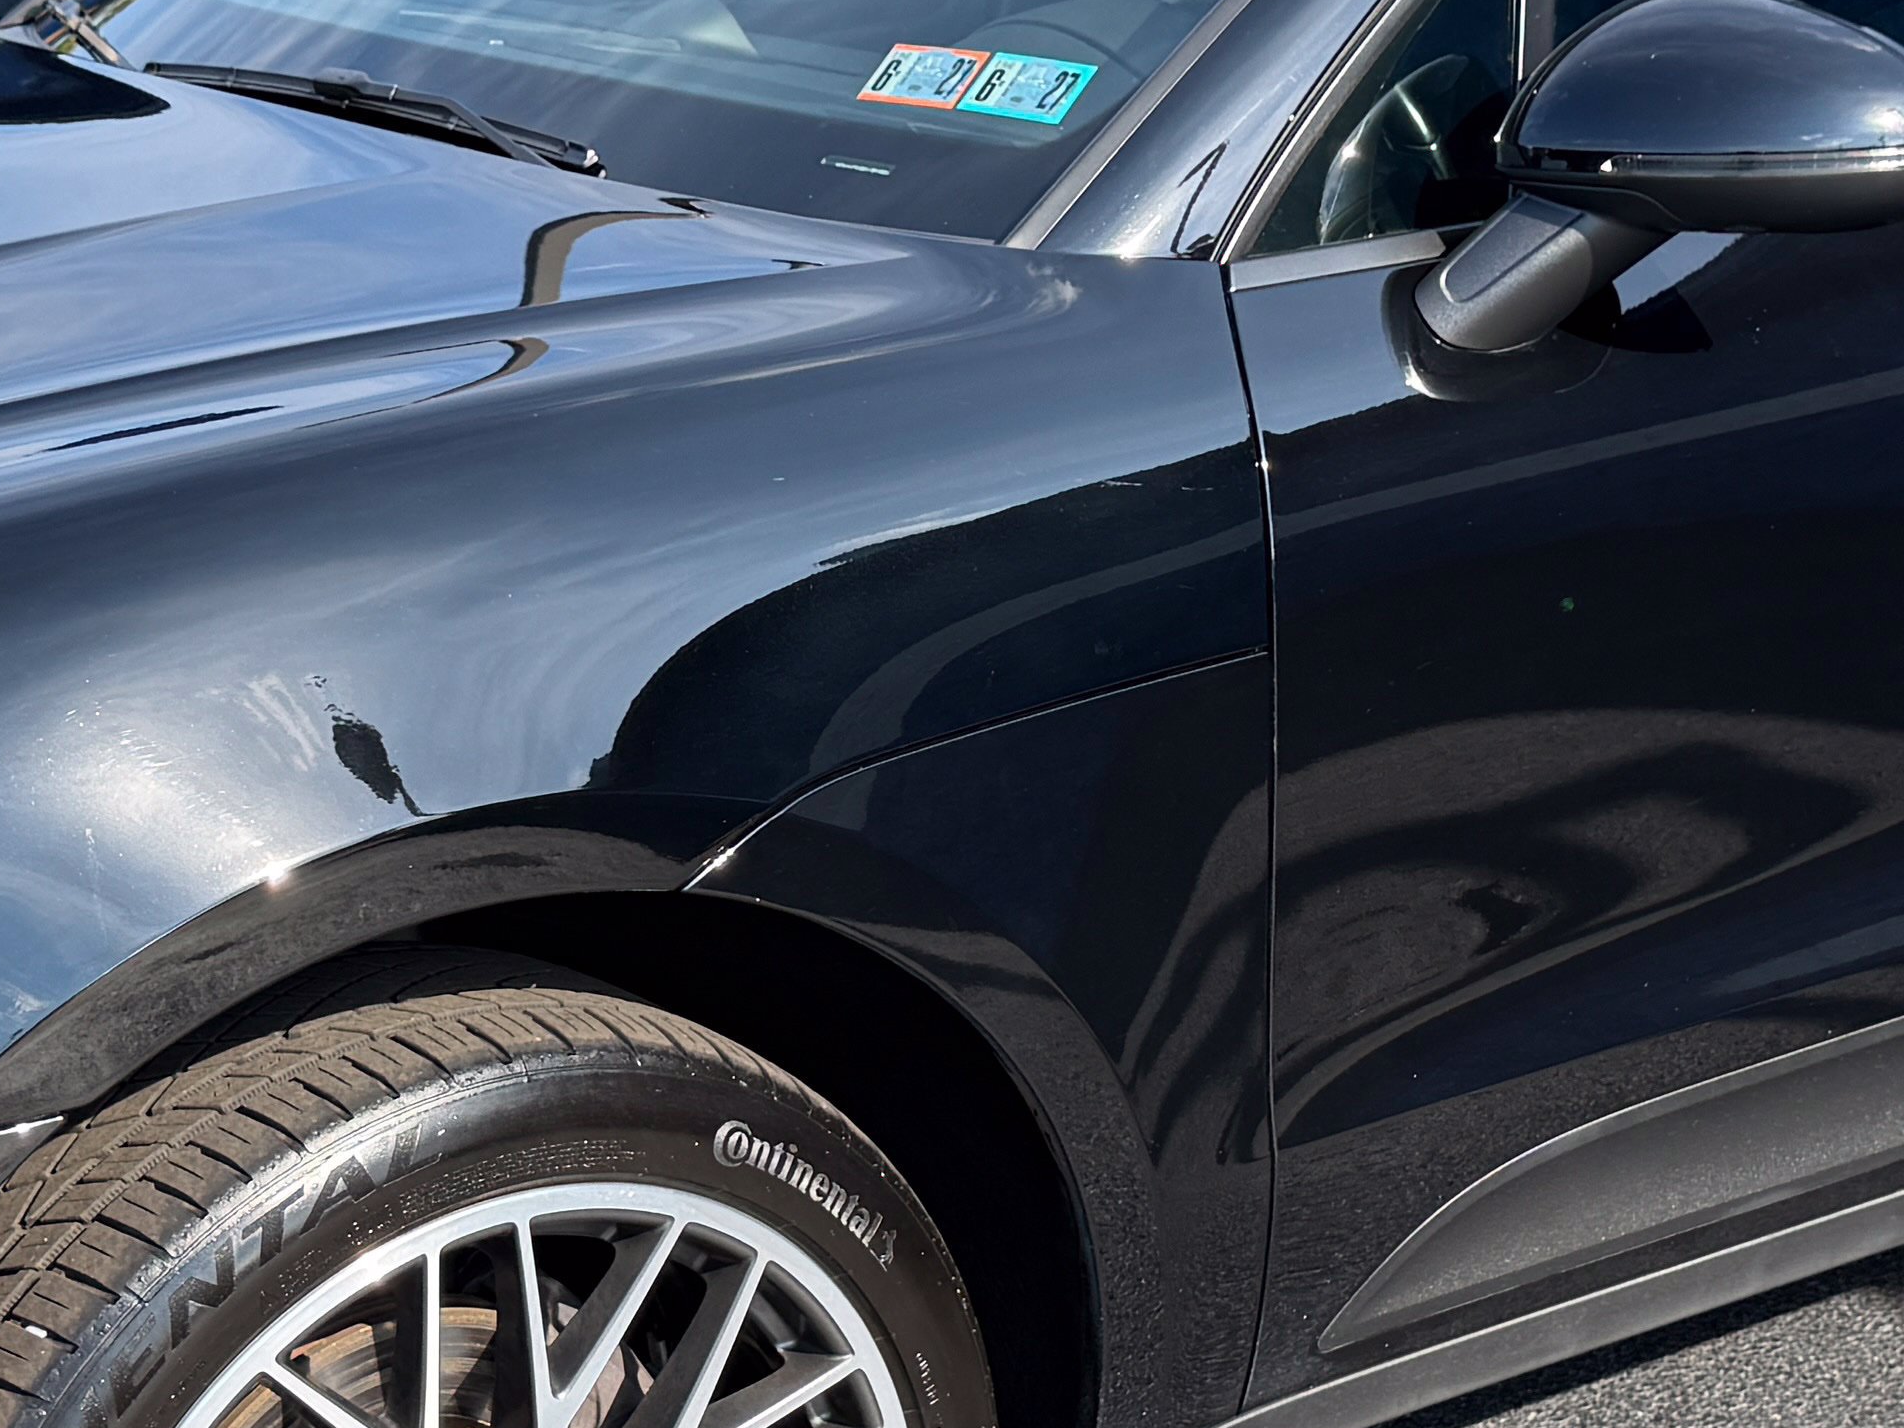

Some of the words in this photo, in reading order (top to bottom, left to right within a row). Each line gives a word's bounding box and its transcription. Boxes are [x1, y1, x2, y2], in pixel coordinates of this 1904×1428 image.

[871, 59, 901, 91] 6
[934, 58, 977, 98] 27
[975, 69, 1005, 102] 6
[1035, 71, 1081, 111] 27
[711, 1119, 884, 1248] Continental
